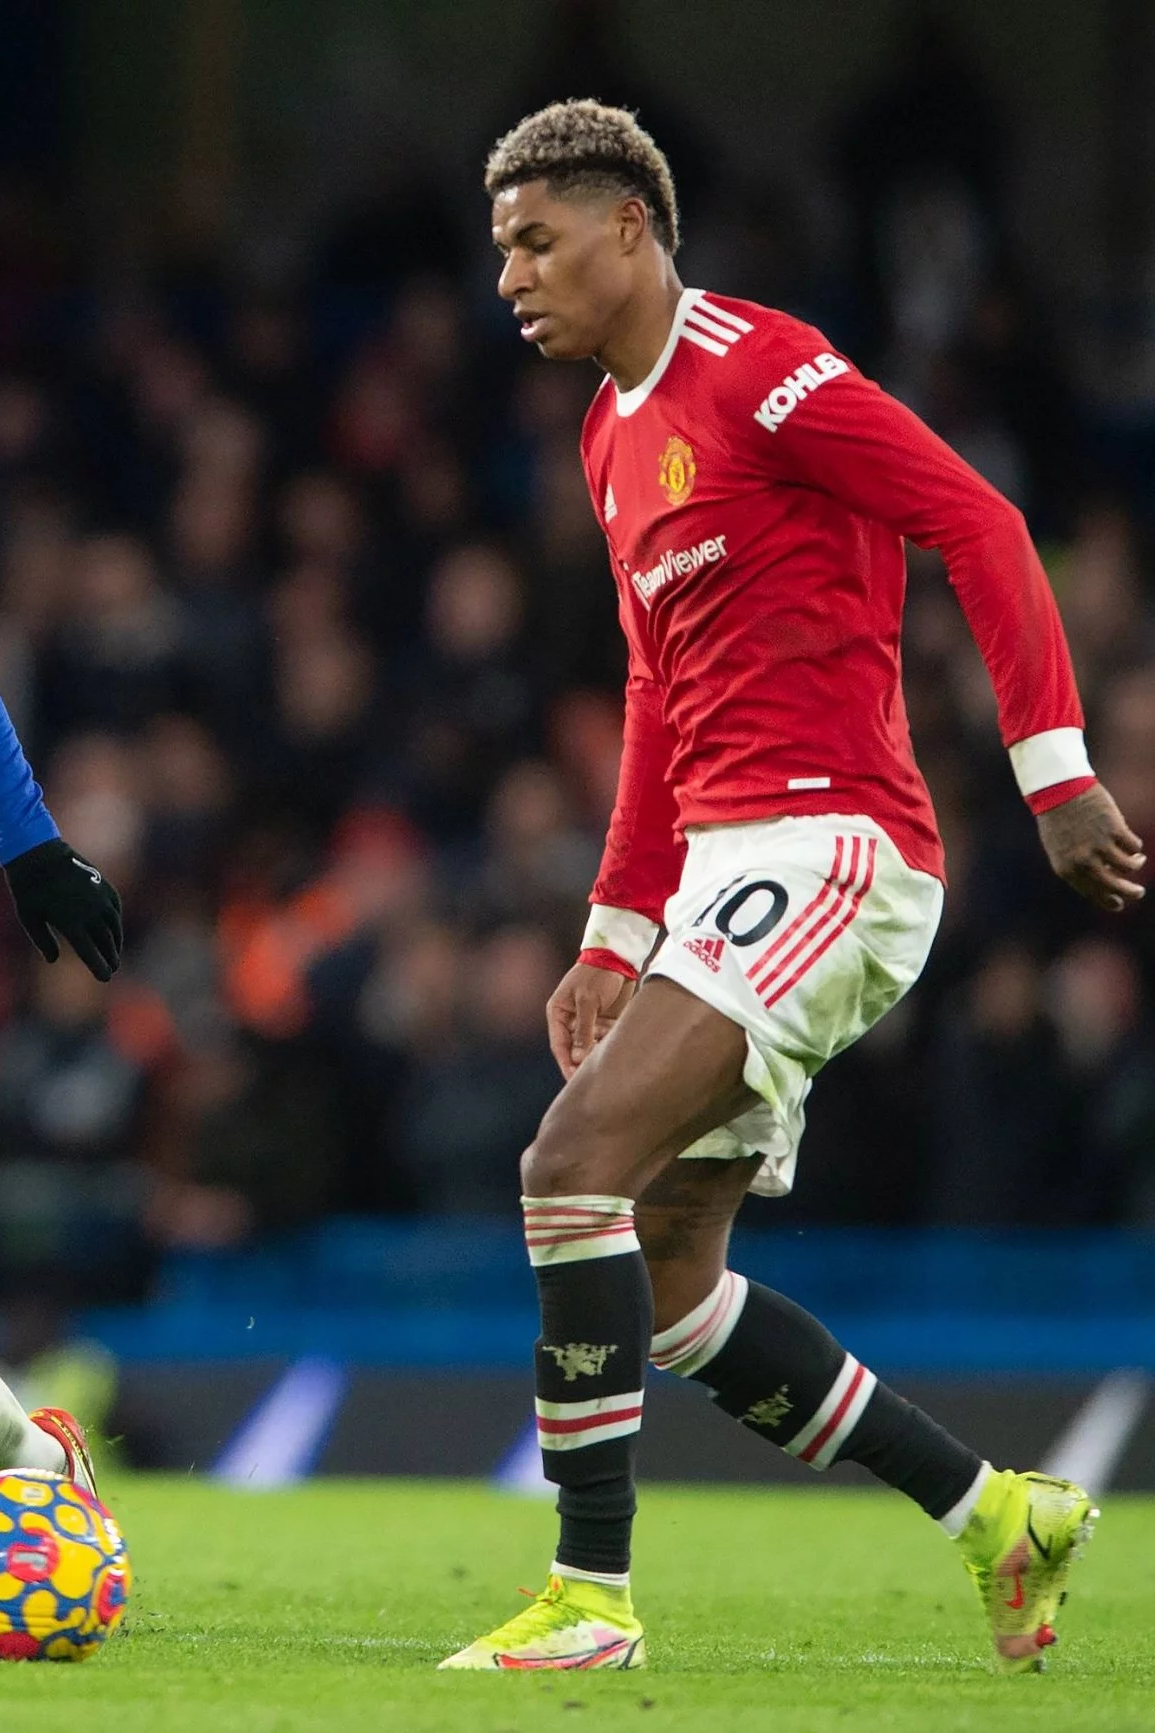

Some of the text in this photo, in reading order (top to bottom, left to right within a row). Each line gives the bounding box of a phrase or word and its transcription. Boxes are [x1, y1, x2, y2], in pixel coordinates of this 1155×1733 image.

[632, 534, 727, 612] TeamViewer
[691, 874, 789, 947] 10
[683, 940, 721, 973] adidas
